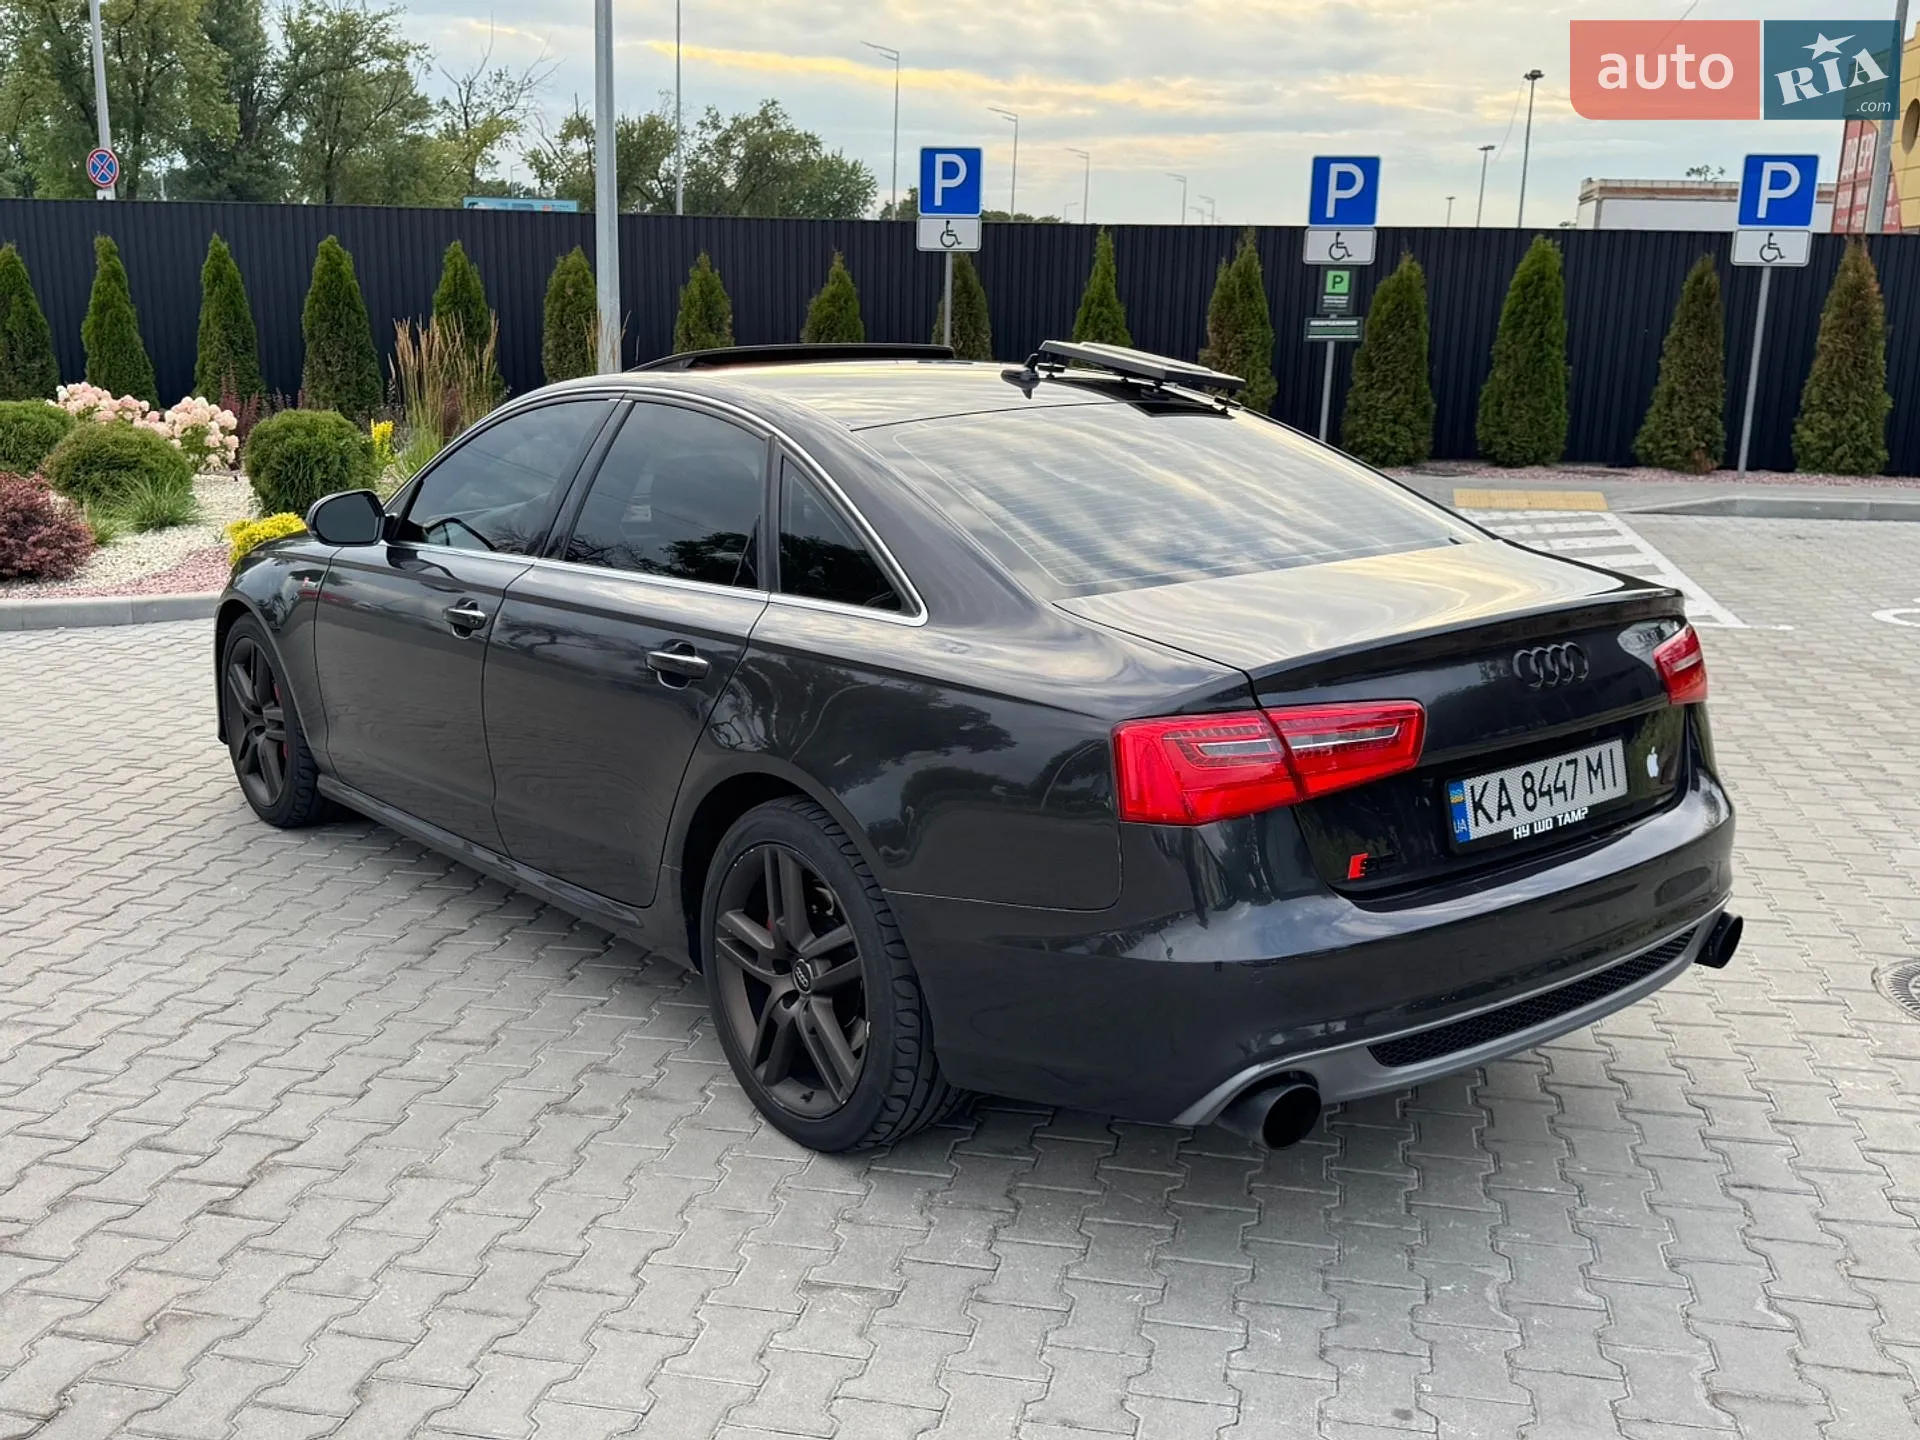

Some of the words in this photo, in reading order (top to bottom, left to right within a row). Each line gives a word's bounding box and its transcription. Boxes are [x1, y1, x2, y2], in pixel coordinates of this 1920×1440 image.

[934, 153, 967, 206] P
[1325, 163, 1365, 218] P
[1757, 162, 1801, 218] P
[1331, 274, 1344, 289] P
[1470, 777, 1516, 827] KA
[1521, 757, 1579, 812] 8447
[1586, 748, 1617, 795] MI
[1453, 817, 1468, 834] UA
[1513, 823, 1530, 840] НУ
